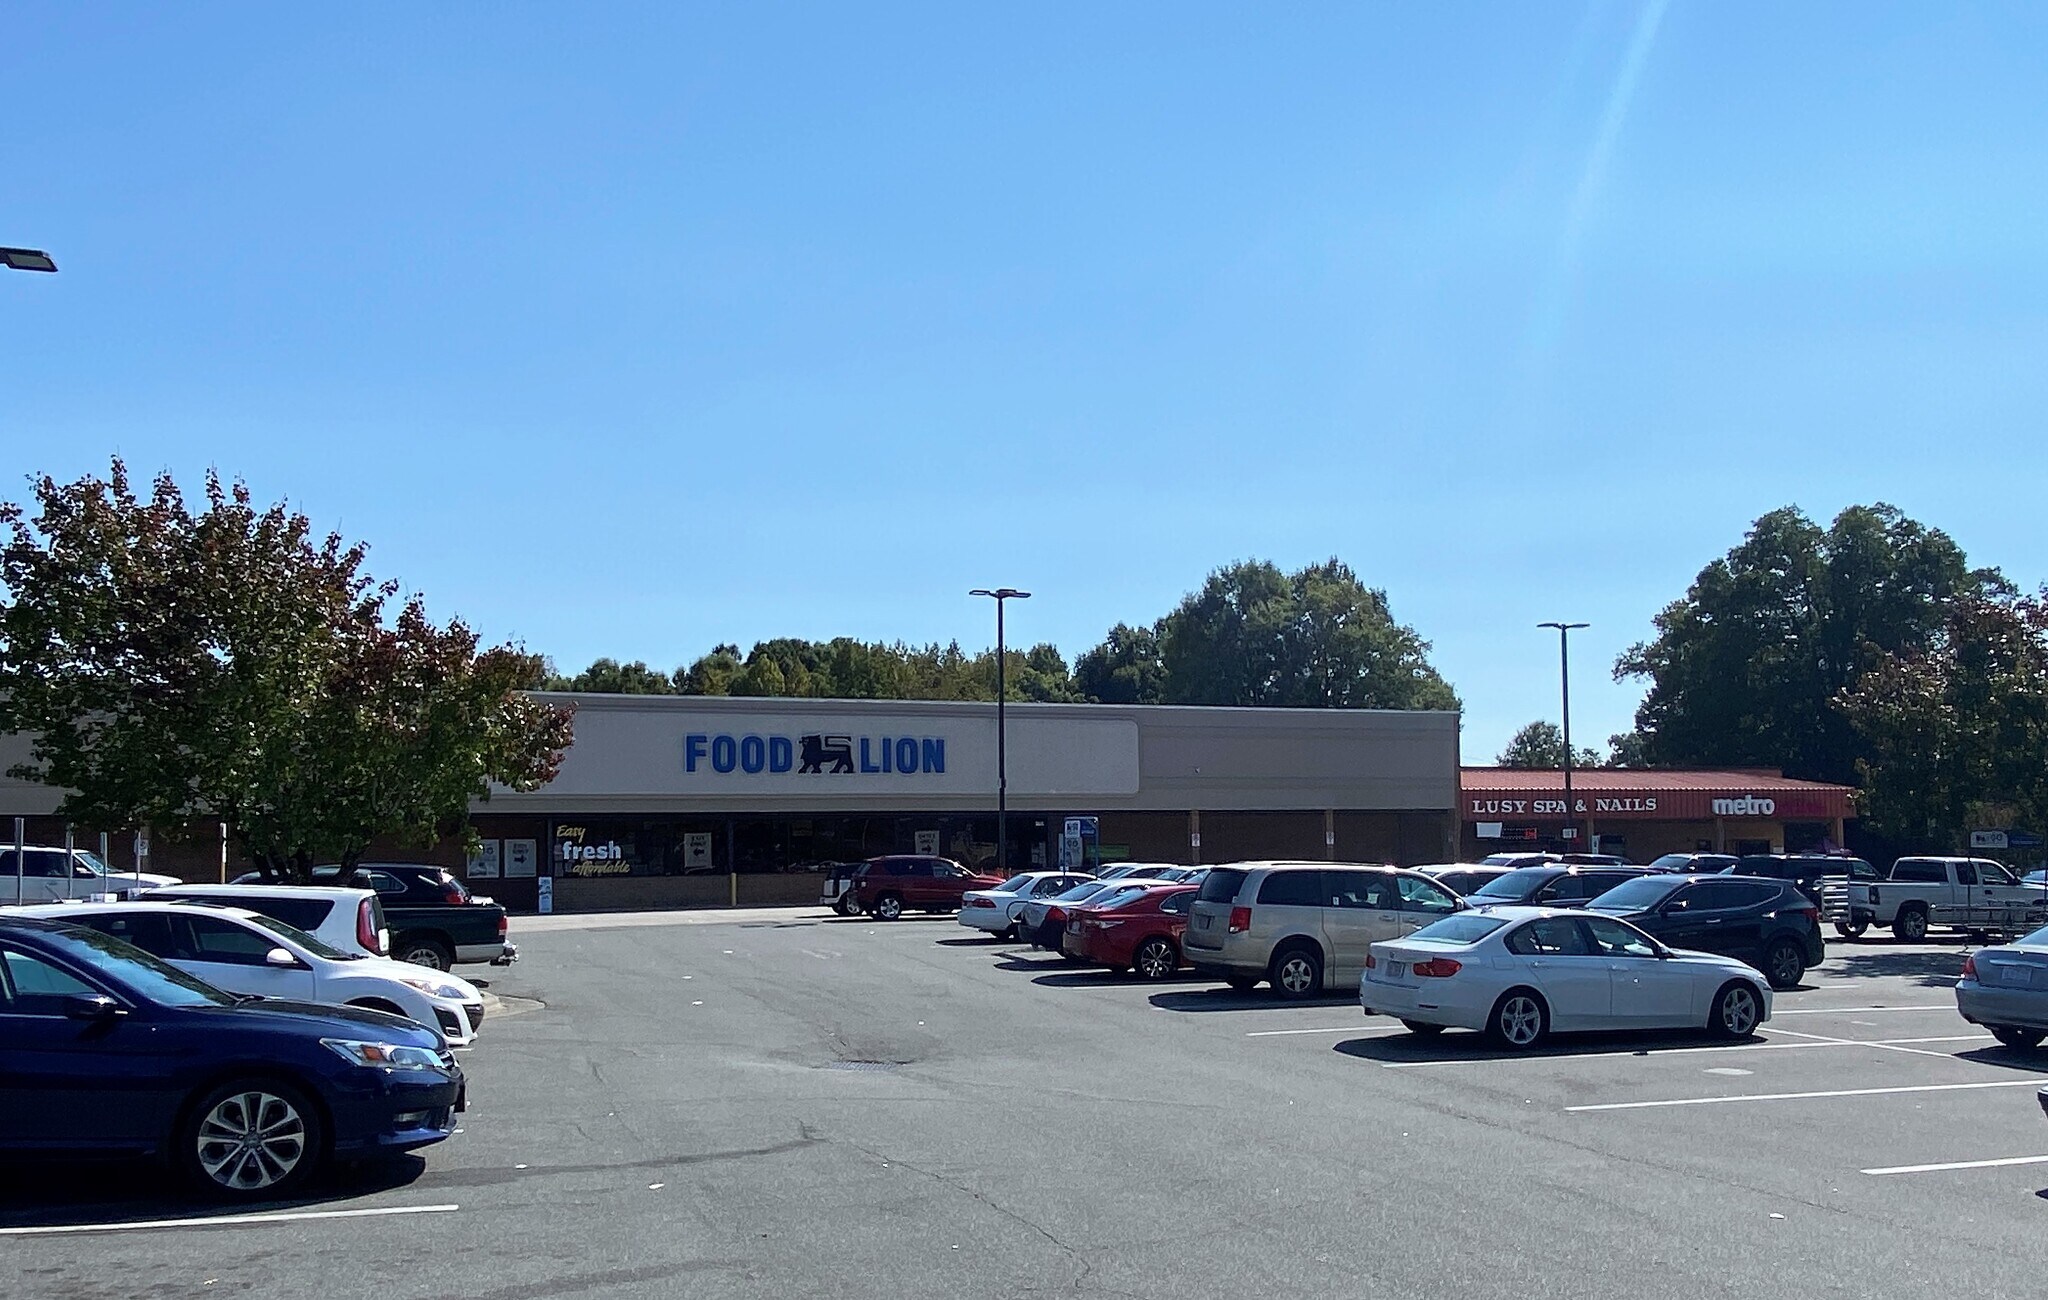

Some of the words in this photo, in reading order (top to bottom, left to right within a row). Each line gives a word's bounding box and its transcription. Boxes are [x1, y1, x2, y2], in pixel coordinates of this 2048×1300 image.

[685, 735, 793, 774] FOOD
[860, 737, 946, 774] LION
[1473, 800, 1527, 813] LUSY
[1533, 800, 1567, 813] SPA
[1575, 800, 1587, 812] &
[1596, 798, 1657, 812] NAILS
[1712, 795, 1775, 815] metro
[556, 825, 586, 844] Easy
[562, 841, 621, 860] fresh
[573, 860, 630, 877] affordable
